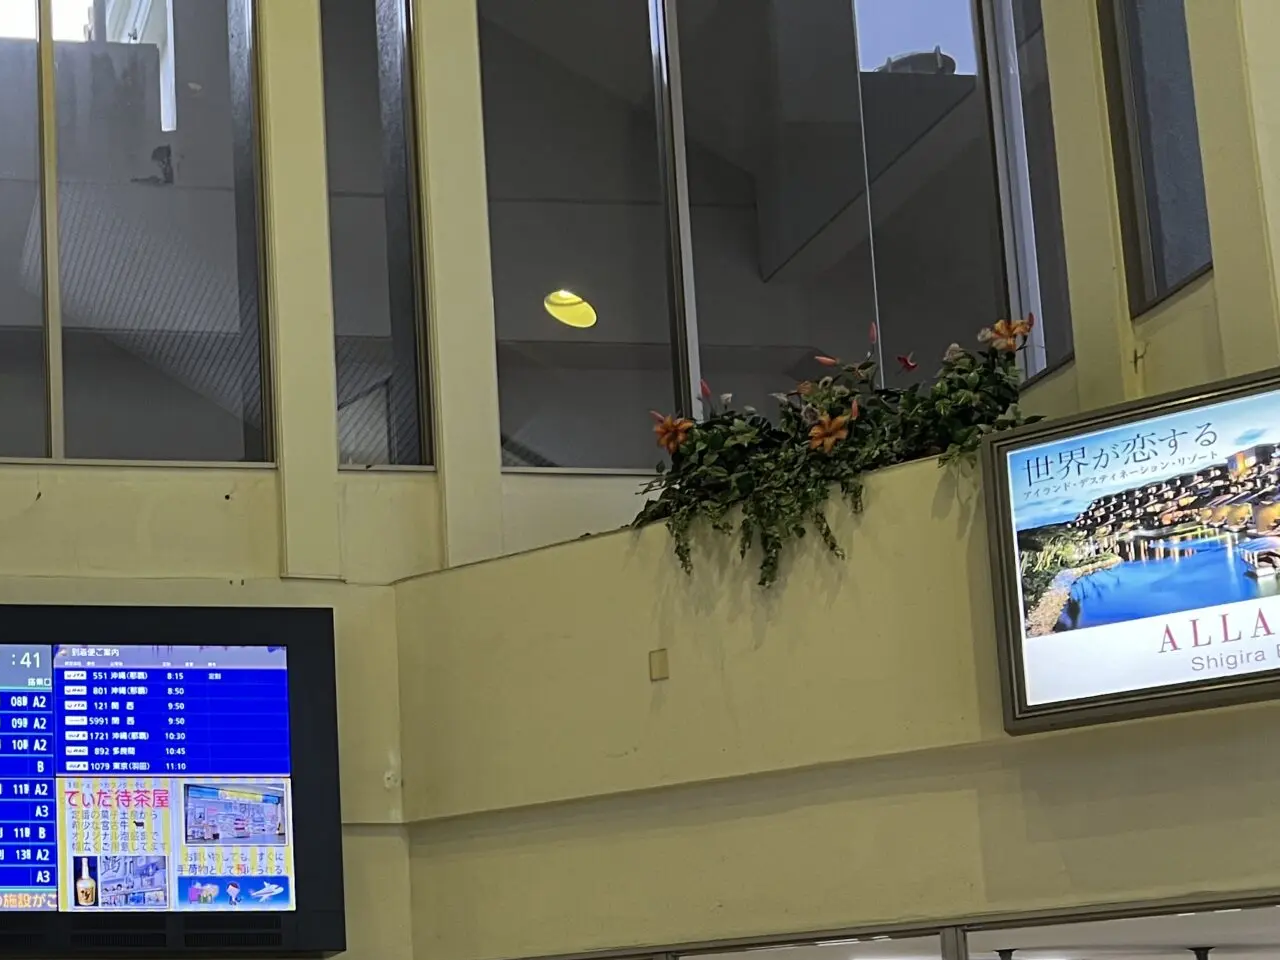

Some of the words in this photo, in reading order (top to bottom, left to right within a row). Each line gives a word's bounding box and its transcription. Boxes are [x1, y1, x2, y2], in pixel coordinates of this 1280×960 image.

[1022, 422, 1218, 487] 世界が恋する
[1023, 452, 1218, 499] アイランド・デスティネーション・リゾート
[1158, 607, 1275, 653] ALLA
[1191, 650, 1266, 671] Shigira
[93, 672, 107, 680] 551
[93, 687, 108, 695] 801
[32, 696, 46, 708] A2
[94, 702, 108, 710] 121
[33, 718, 47, 730] A2
[89, 717, 109, 725] 5991
[90, 732, 109, 740] 1721
[33, 740, 47, 751] A2
[94, 748, 109, 756] 892
[37, 761, 45, 773] B
[34, 784, 48, 796] A2
[35, 806, 49, 817] A3
[38, 828, 46, 839] B
[36, 849, 50, 861] A2
[36, 871, 50, 883] A3
